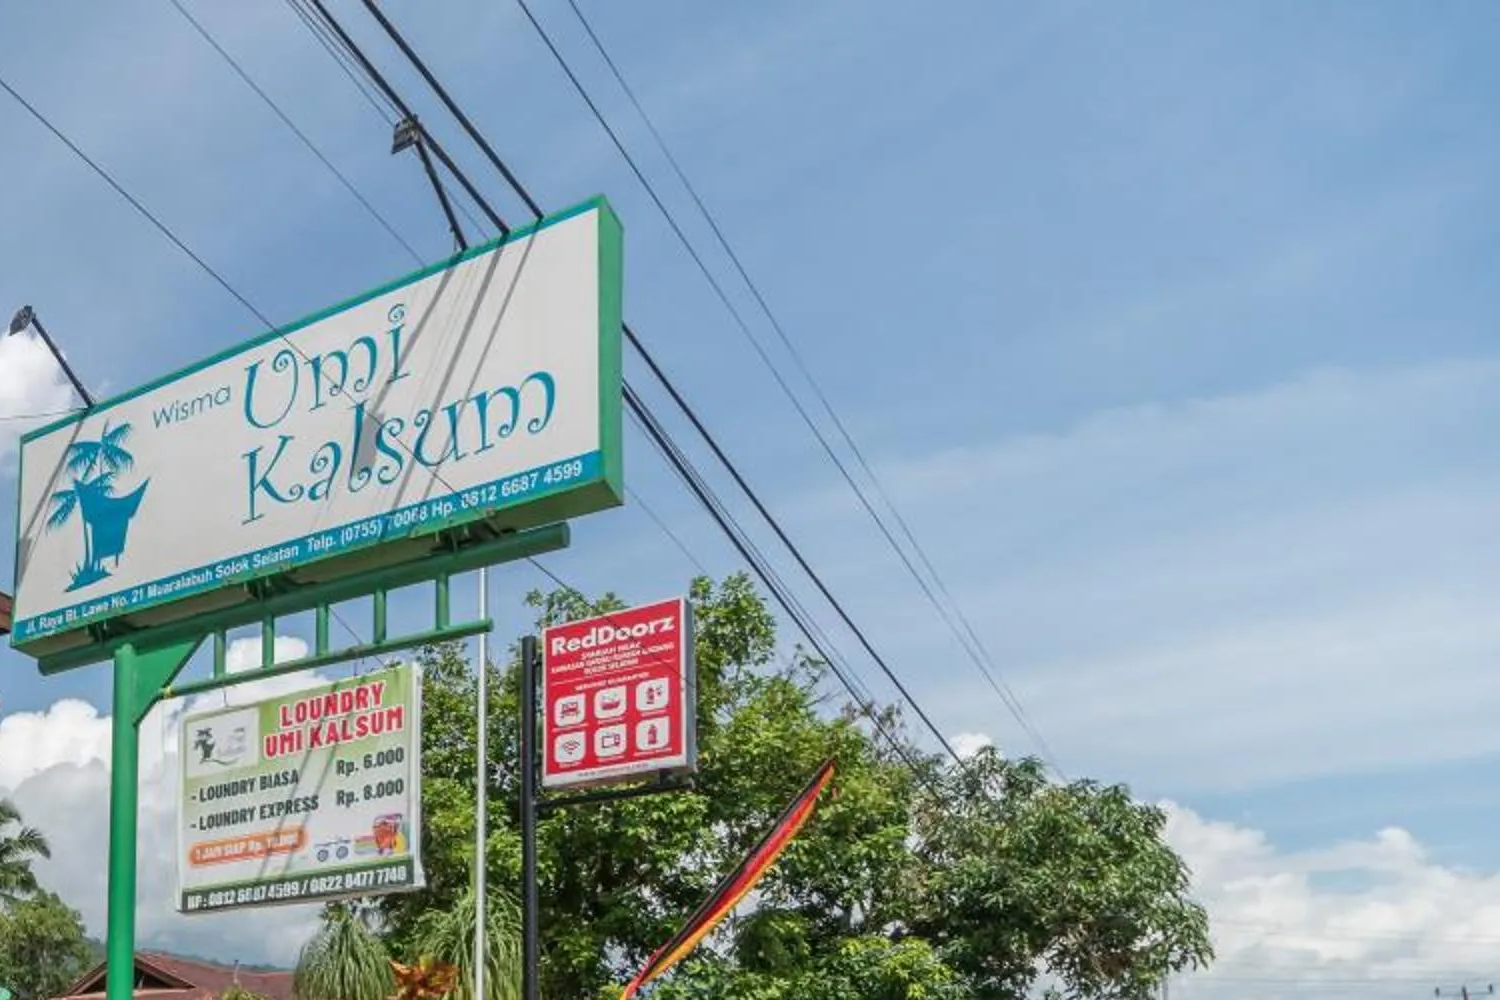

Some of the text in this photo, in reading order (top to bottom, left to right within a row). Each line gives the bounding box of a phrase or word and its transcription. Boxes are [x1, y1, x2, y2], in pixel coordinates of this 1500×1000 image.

[153, 304, 412, 430] Wisma Umi
[241, 370, 556, 527] Kalsum
[132, 587, 144, 603] 21
[215, 560, 250, 579] Solok
[252, 545, 299, 569] Selatan
[307, 533, 338, 553] Telp.
[432, 499, 456, 519] Hp.
[501, 473, 538, 498] 6687
[543, 459, 583, 483] 4599
[551, 616, 676, 656] RedDoorz
[280, 680, 387, 728] LOUNDRY
[264, 730, 303, 758] UMI
[309, 705, 405, 748] KALSUM
[199, 780, 256, 802] LOUNDRY
[259, 769, 300, 791] BIASA
[336, 758, 359, 777] Rp.
[199, 808, 256, 831] LOUNDRY
[259, 795, 320, 819] EXPRESS
[336, 788, 359, 807] Rp.
